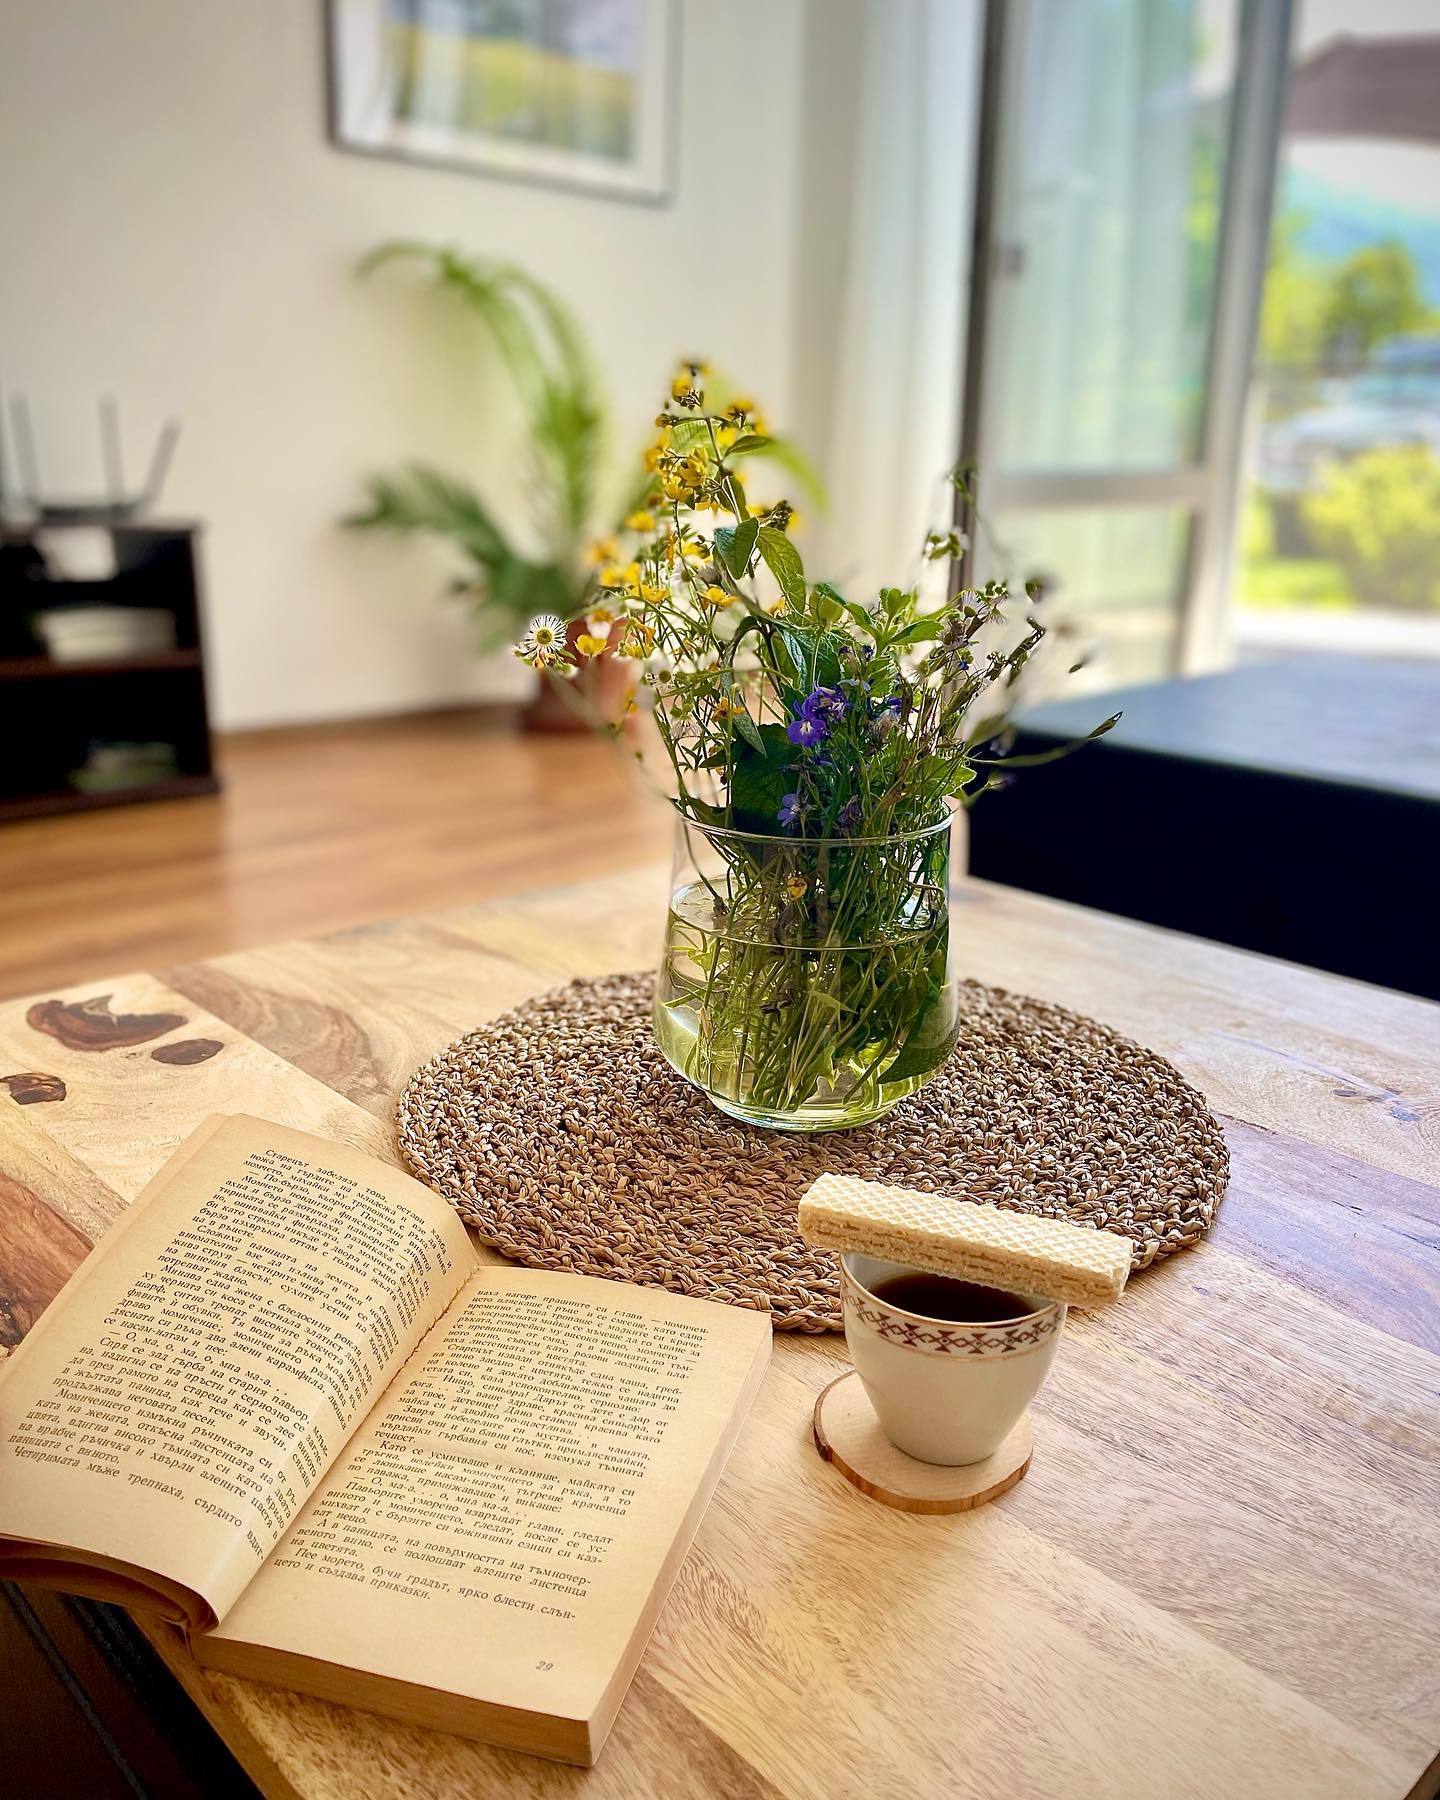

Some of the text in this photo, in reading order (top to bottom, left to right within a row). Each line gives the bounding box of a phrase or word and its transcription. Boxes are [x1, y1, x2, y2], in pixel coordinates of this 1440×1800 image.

[156, 1254, 210, 1273] потрепват
[102, 1317, 116, 1325] се
[119, 1319, 189, 1343] насам-натам
[191, 1339, 201, 1347] и
[159, 1263, 202, 1281] Минава
[205, 1278, 231, 1290] една
[233, 1286, 263, 1302] жена
[276, 1302, 331, 1333] бледосиня
[362, 1362, 373, 1386] вър-
[51, 1377, 122, 1397] продължава
[125, 1392, 177, 1413] неговата
[6, 1434, 62, 1449] паницата
[64, 1443, 73, 1452] с
[34, 1398, 62, 1410] ката
[65, 1404, 82, 1413] на
[136, 1421, 185, 1441] откъсна
[188, 1438, 255, 1473] листенцата
[259, 1471, 274, 1485] на
[273, 1487, 291, 1519] двата
[54, 1388, 297, 1506] Момиченцето измъкна ръчичката си от ръ-
[67, 1417, 109, 1433] вдигна
[112, 1428, 156, 1446] високо
[161, 1441, 211, 1465] тъмната
[215, 1463, 231, 1474] си
[235, 1472, 263, 1492] като
[265, 1494, 285, 1529] крило
[378, 1439, 407, 1452] Като
[411, 1447, 424, 1455] се
[430, 1450, 489, 1468] усмихваше
[494, 1463, 503, 1471] и
[567, 1477, 615, 1493] майката
[620, 1488, 635, 1497] си
[13, 1444, 80, 1467] Четиримата
[85, 1462, 120, 1477] мъже
[193, 1497, 242, 1527] сърдито
[246, 1529, 264, 1560] вдиг-
[16, 1422, 278, 1540] на врабче ръчичка и хвърли алените цветя в
[311, 1508, 333, 1517] ват
[344, 1480, 406, 1500] Павьорите
[412, 1496, 459, 1512] уморено
[463, 1507, 522, 1525] извръщат
[572, 1530, 613, 1544] гледат
[346, 1463, 362, 1471] по
[416, 1476, 496, 1499] примижаваше
[500, 1494, 510, 1502] и
[353, 1455, 367, 1463] се
[371, 1458, 427, 1474] люшкаше
[516, 1487, 564, 1503] тътреше
[571, 1498, 626, 1515] краченца
[288, 1537, 305, 1546] на
[315, 1517, 327, 1527] А
[330, 1521, 339, 1529] в
[404, 1537, 420, 1547] на
[423, 1542, 505, 1566] повърхността
[509, 1560, 525, 1570] на
[528, 1565, 591, 1586] тъмночер-
[318, 1499, 360, 1511] михват
[361, 1506, 371, 1514] и
[385, 1510, 432, 1527] бързите
[434, 1522, 450, 1531] си
[453, 1526, 513, 1545] южняшки
[516, 1540, 553, 1554] езици
[556, 1548, 571, 1558] си
[575, 1552, 602, 1563] каз-
[325, 1489, 366, 1502] виното
[371, 1498, 381, 1506] и
[523, 1531, 559, 1543] после
[565, 1539, 580, 1548] се
[589, 1544, 607, 1553] ус-
[272, 1557, 301, 1568] цето
[303, 1562, 314, 1571] и
[317, 1565, 365, 1582] създава
[293, 1546, 318, 1560] Пее
[371, 1565, 402, 1579] бучи
[457, 1586, 489, 1599] ярко
[492, 1593, 535, 1611] блести
[539, 1605, 576, 1619] слън-
[296, 1527, 336, 1540] веното
[382, 1544, 397, 1554] се
[403, 1549, 466, 1569] полюшват
[472, 1565, 522, 1582] алените
[528, 1577, 587, 1597] листенца
[535, 1660, 554, 1672] 29
